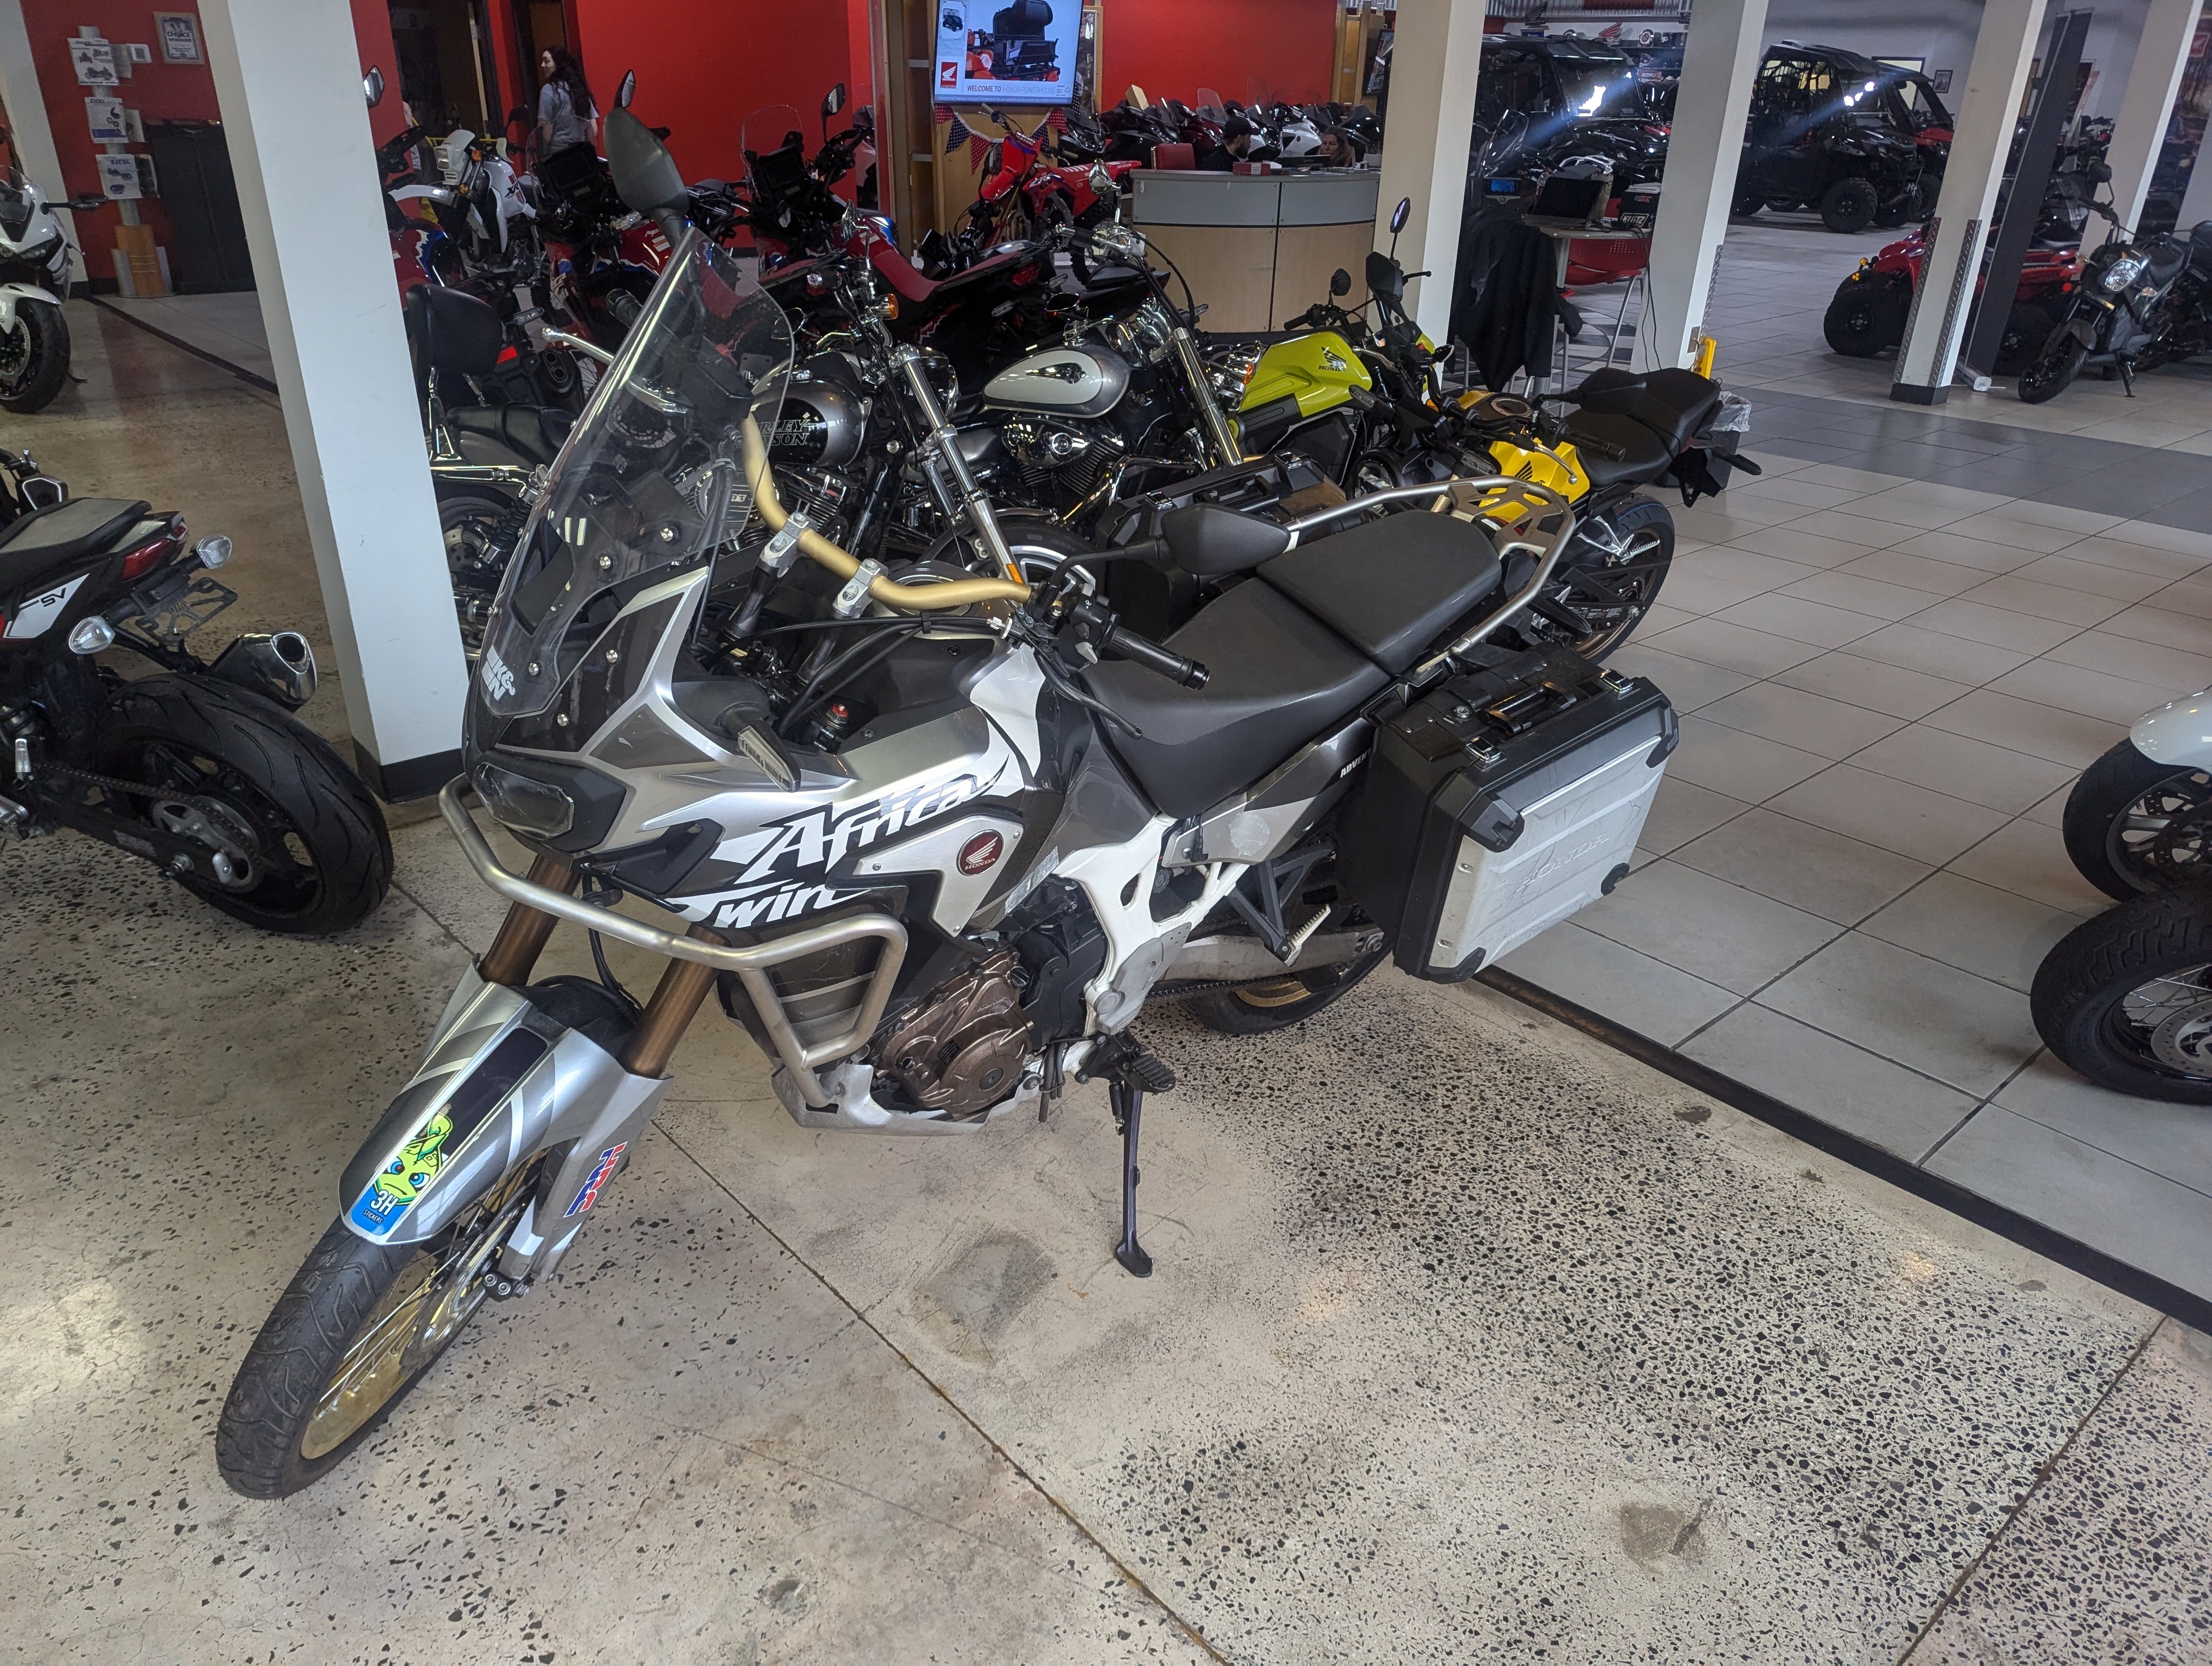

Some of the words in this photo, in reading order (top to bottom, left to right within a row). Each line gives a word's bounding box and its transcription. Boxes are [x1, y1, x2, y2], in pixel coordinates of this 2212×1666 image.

[504, 182, 519, 198] XR
[757, 419, 811, 433] RLEY
[40, 587, 66, 607] SV
[486, 657, 516, 701] K&N
[1340, 748, 1372, 778] ADVENT
[733, 770, 992, 885] Africa
[964, 857, 996, 870] HONDA
[1516, 832, 1610, 893] HONDA
[664, 879, 863, 928] Twin
[563, 1141, 628, 1218] HRC
[362, 1209, 384, 1225] STICKERS
[370, 1189, 401, 1217] 3H
